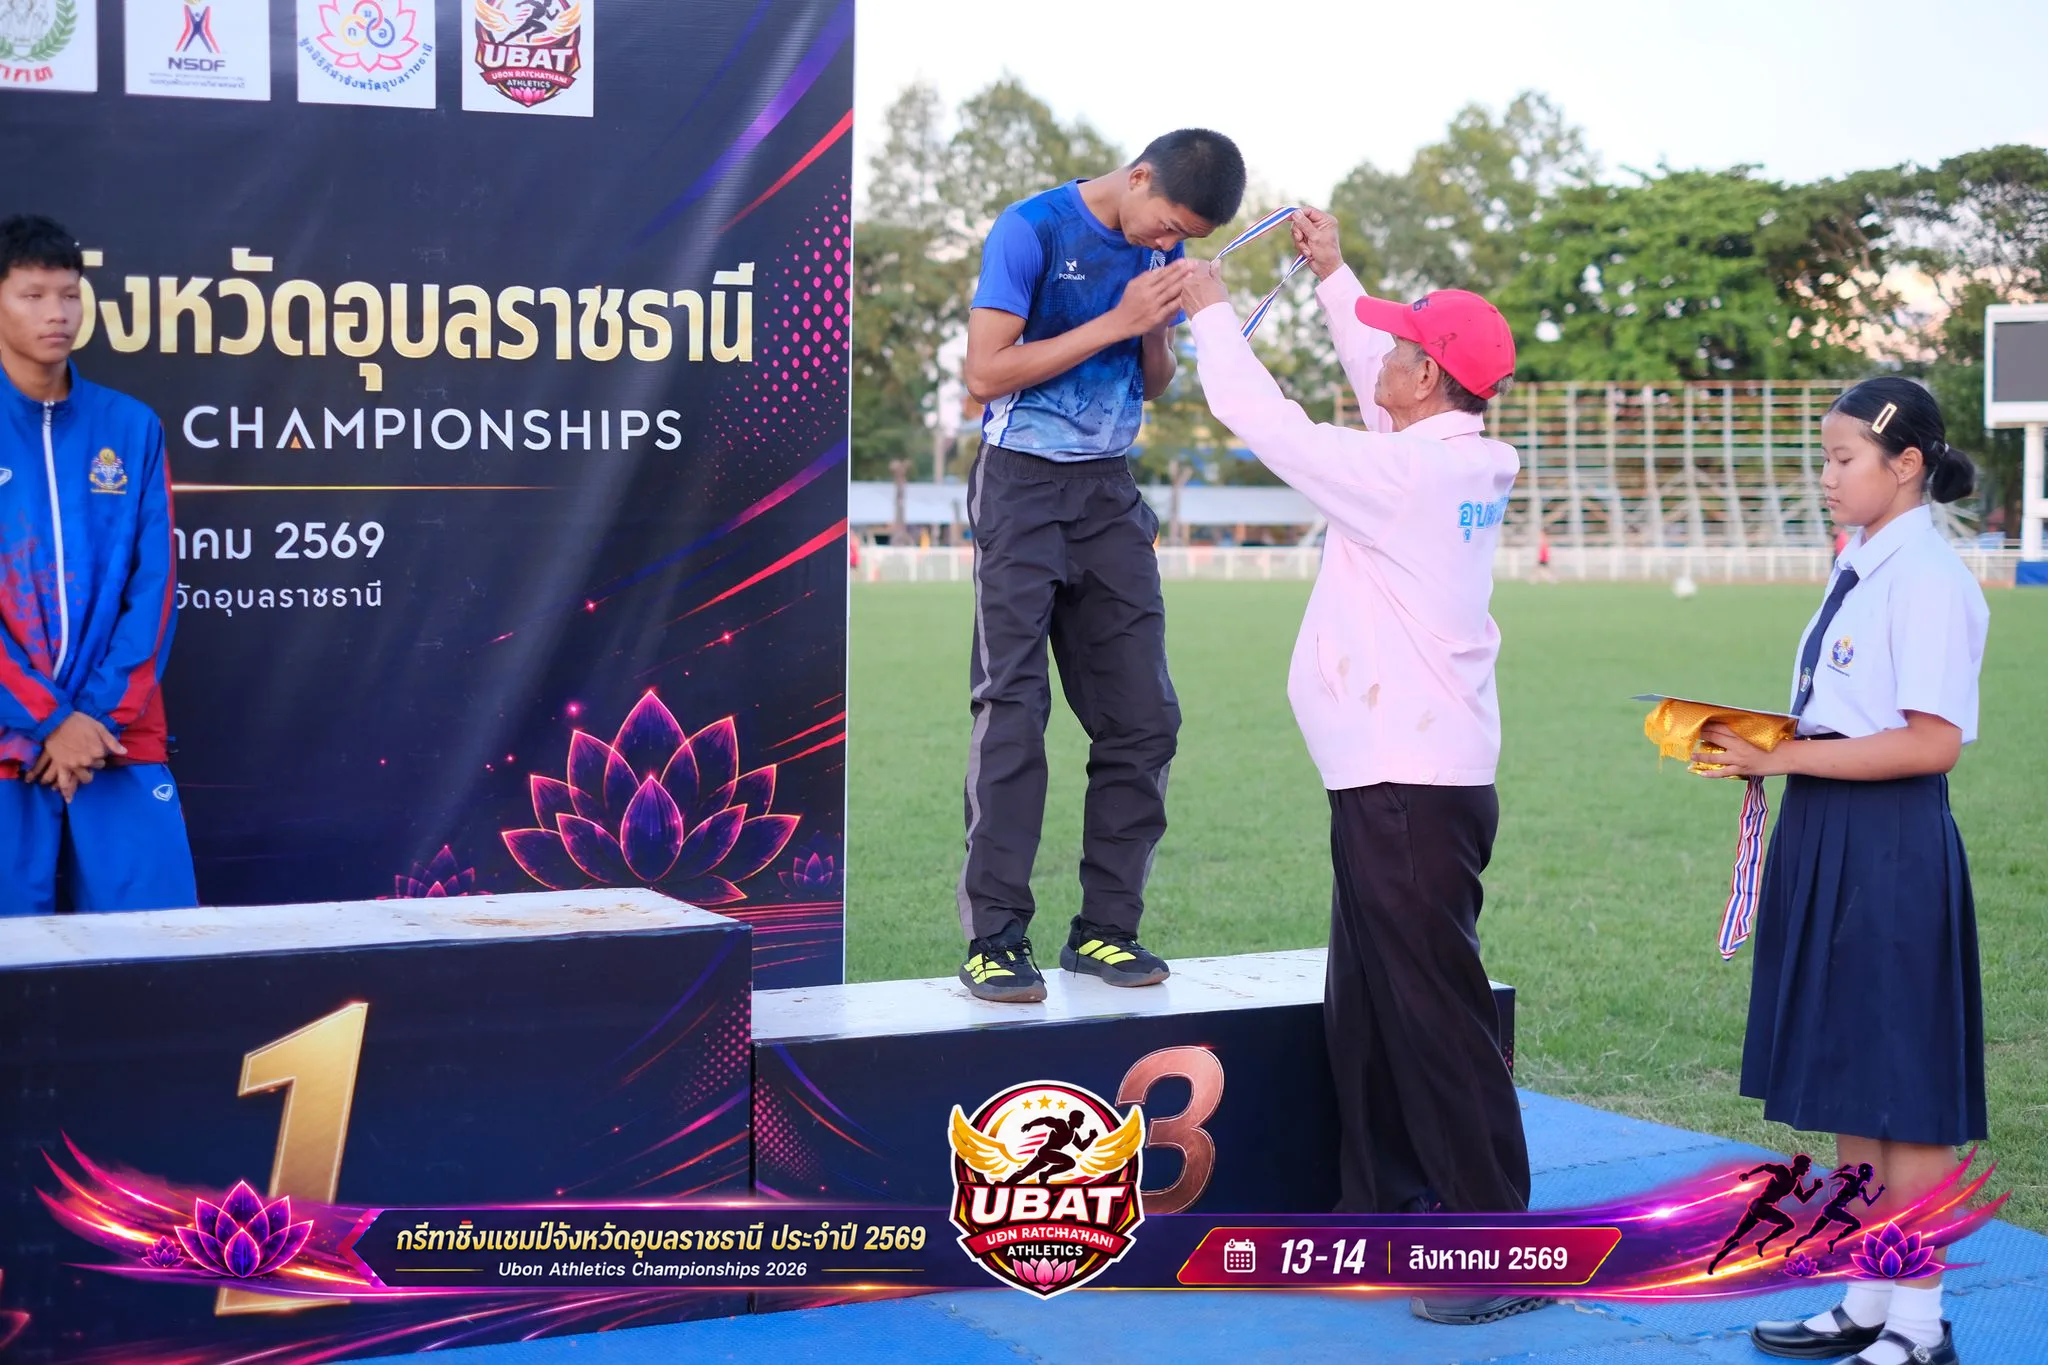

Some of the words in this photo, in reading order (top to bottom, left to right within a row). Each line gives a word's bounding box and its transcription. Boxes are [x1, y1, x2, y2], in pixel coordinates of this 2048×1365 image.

[168, 56, 226, 72] NSDF
[483, 43, 574, 72] UBAT
[506, 80, 551, 88] ATHLETICS
[182, 405, 684, 452] CHAMPIONSHIPS
[274, 521, 385, 559] 2569
[1114, 1045, 1225, 1215] 3
